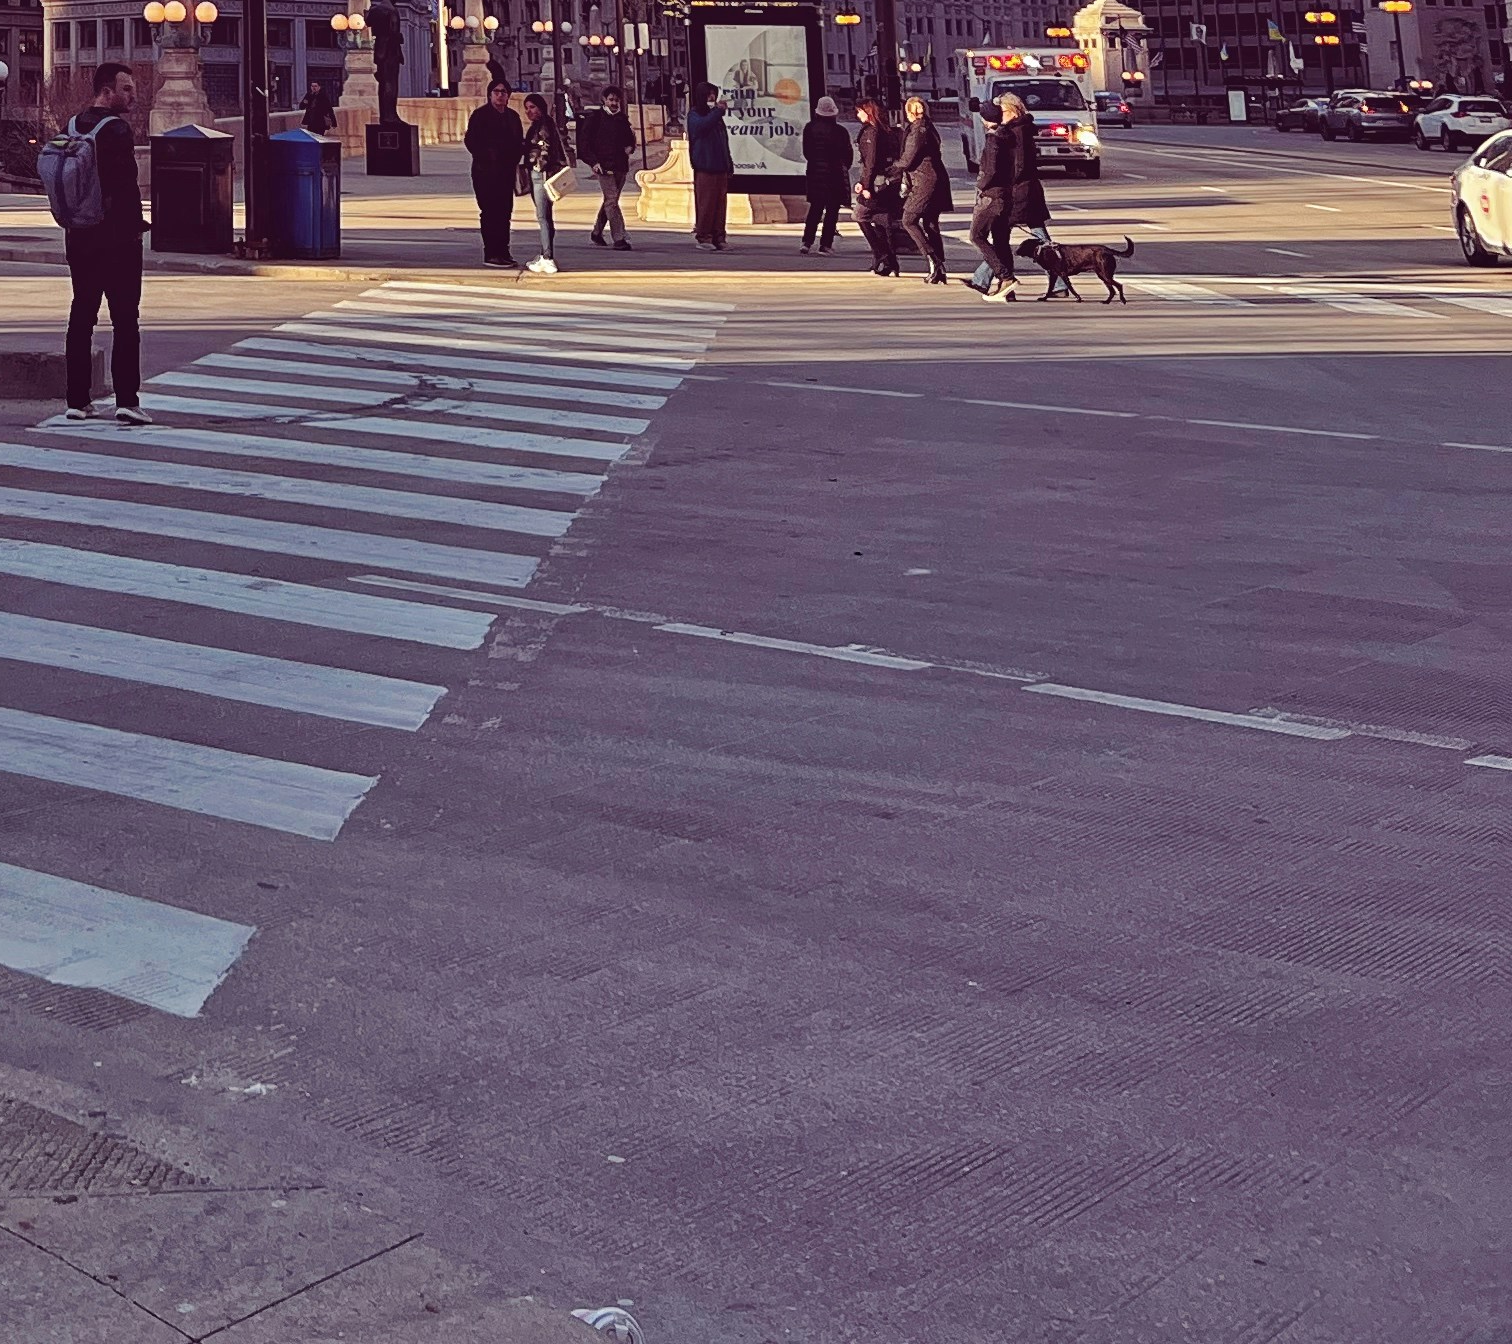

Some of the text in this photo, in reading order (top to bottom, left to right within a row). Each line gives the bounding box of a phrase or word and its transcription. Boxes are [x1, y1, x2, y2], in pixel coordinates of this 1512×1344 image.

[721, 87, 756, 101] rain
[735, 107, 776, 121] your
[726, 121, 800, 139] ream job.
